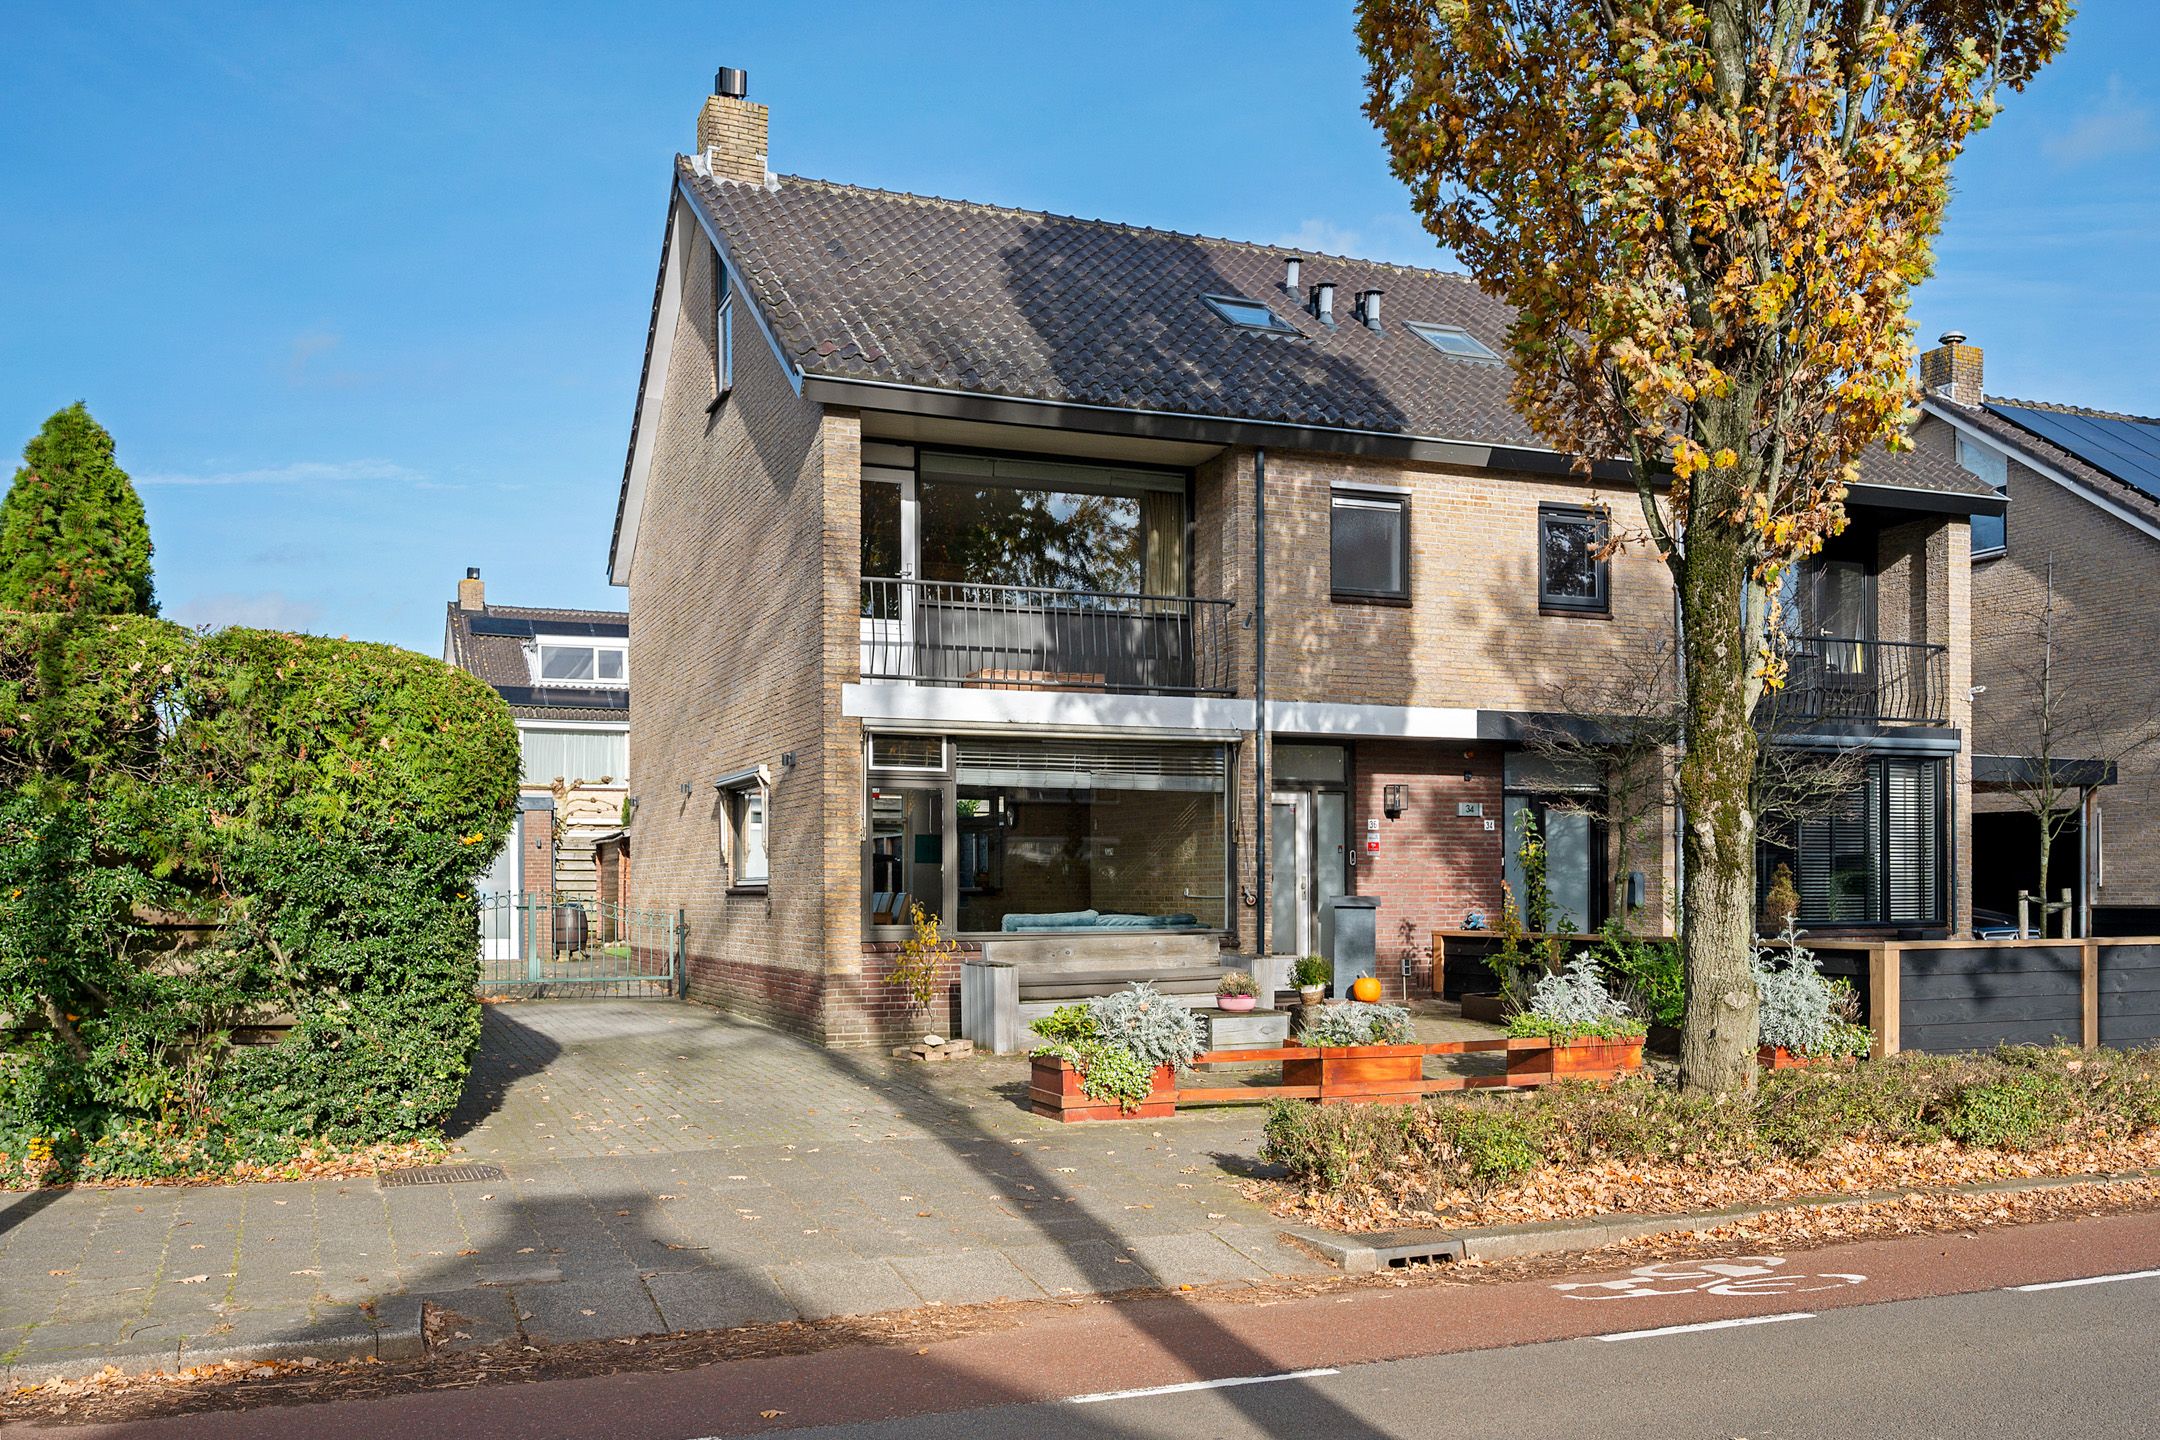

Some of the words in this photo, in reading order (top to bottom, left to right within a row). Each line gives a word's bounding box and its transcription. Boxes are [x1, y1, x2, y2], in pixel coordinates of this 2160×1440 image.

[1465, 804, 1474, 813] 34
[1369, 820, 1378, 829] 36
[1485, 821, 1493, 830] 34
